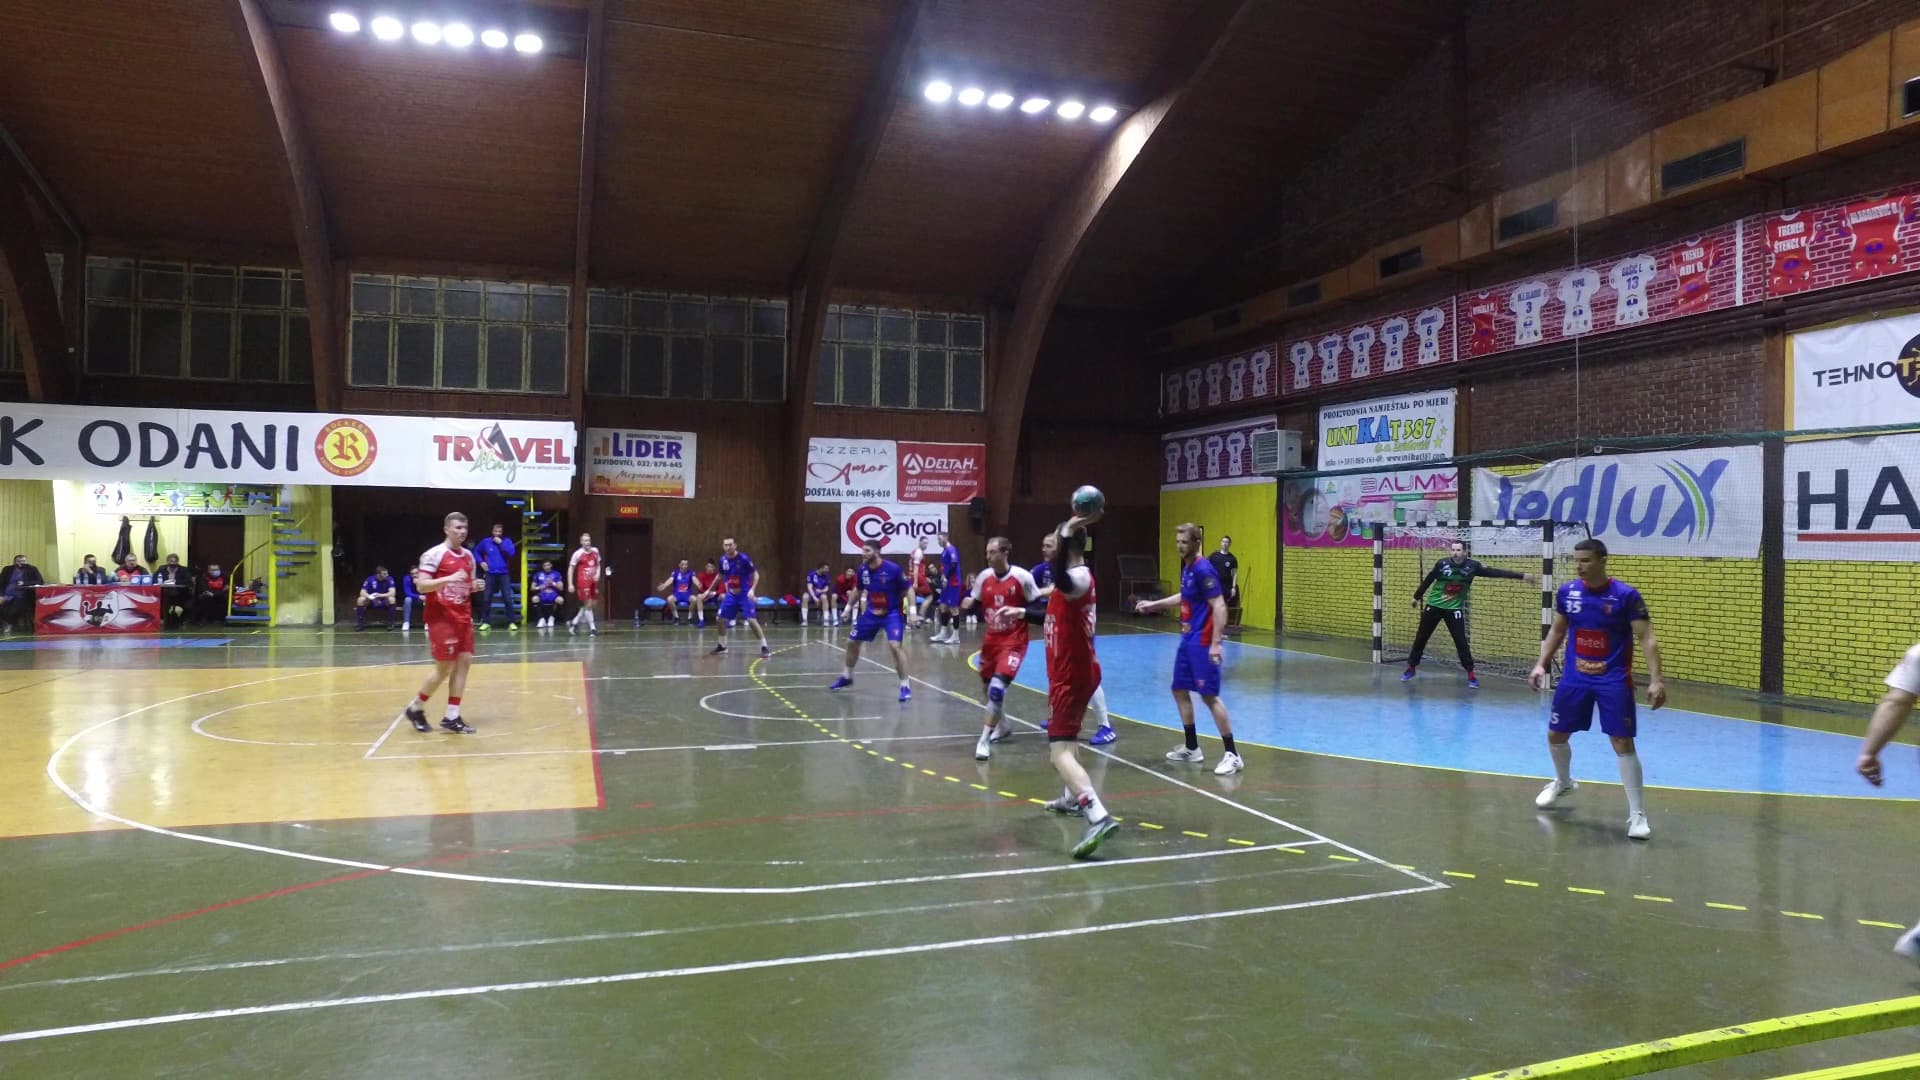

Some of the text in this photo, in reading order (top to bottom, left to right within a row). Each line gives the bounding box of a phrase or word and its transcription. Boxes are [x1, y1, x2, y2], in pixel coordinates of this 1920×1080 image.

[1626, 275, 1640, 290] 13
[1526, 301, 1532, 314] 3
[1813, 357, 1920, 387] TEHNOT
[1413, 400, 1424, 409] PO
[1426, 397, 1449, 407] MJERI
[0, 416, 299, 471] K ODANI
[433, 422, 570, 464] TRAVEL
[613, 432, 682, 460] LIDER
[808, 445, 888, 456] PIZZERIA
[807, 462, 888, 486] Amor
[805, 487, 844, 498] DOSTAVA:
[1797, 466, 1920, 530] HA
[860, 517, 942, 539] Central
[1565, 600, 1582, 613] 35
